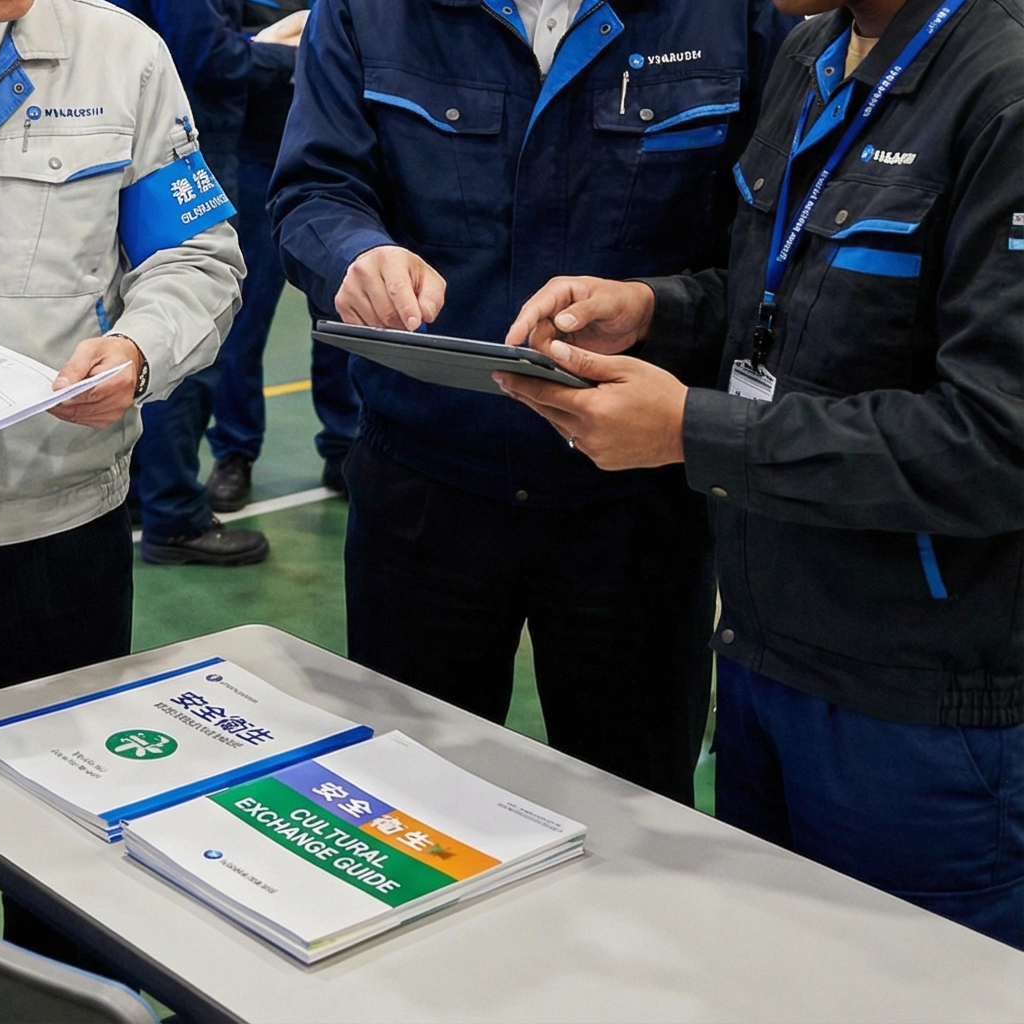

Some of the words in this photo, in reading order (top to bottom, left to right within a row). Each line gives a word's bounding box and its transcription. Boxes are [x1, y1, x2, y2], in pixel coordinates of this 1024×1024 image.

[169, 691, 275, 746] 安全衛生
[234, 797, 341, 869] EXCHANGE
[333, 856, 402, 895] GUIDE
[289, 808, 389, 869] CULTURAL
